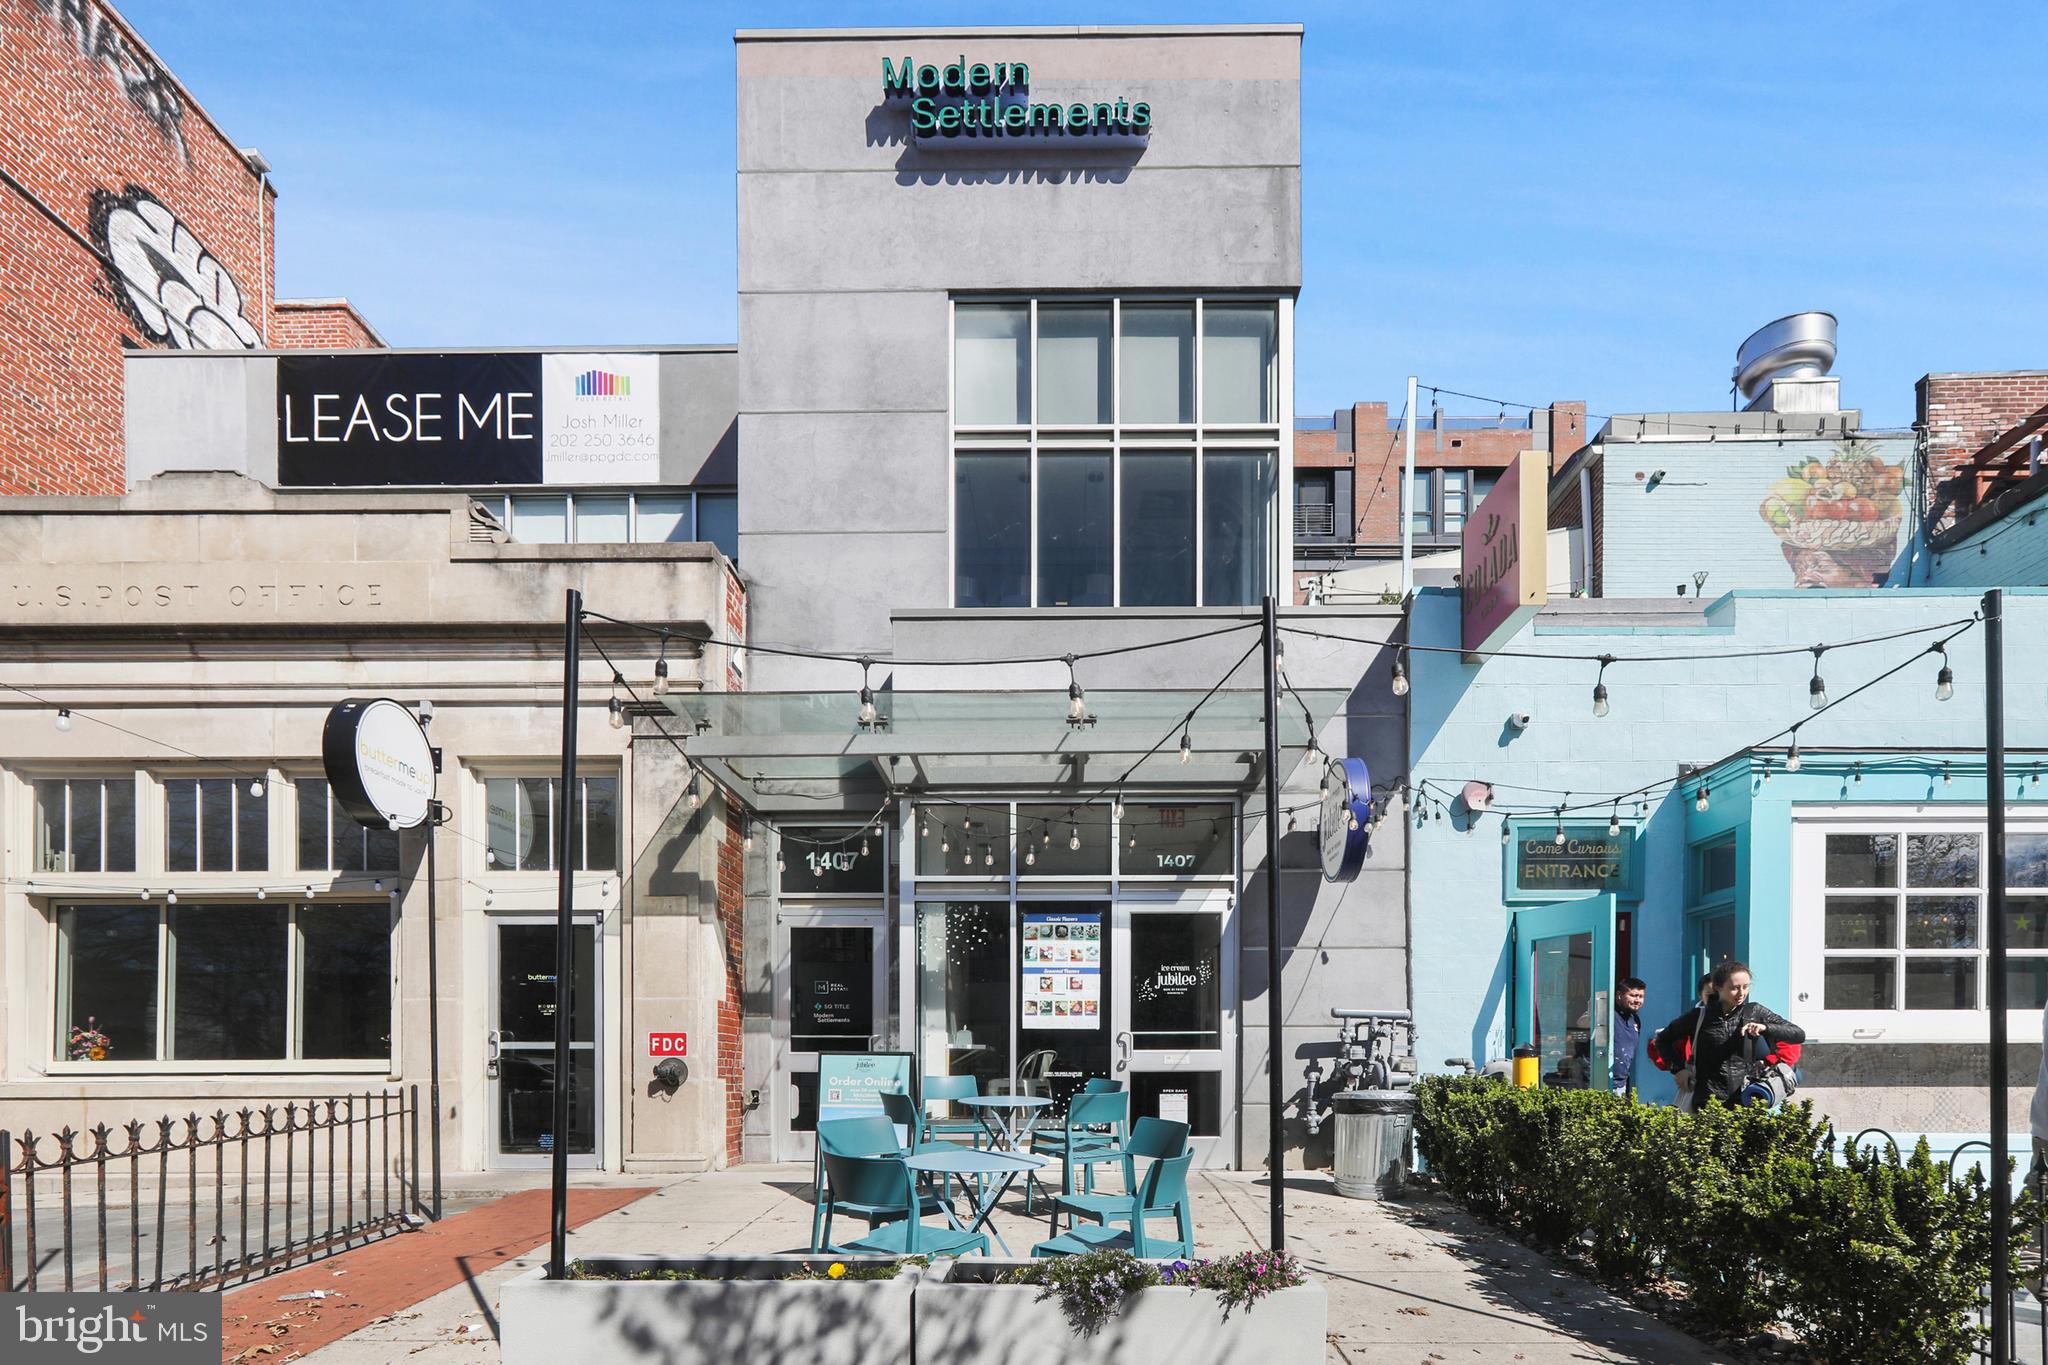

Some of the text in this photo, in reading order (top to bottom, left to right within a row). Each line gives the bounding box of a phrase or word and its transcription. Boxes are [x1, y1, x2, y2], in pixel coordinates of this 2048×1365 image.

[882, 55, 1030, 91] Modern
[912, 97, 1151, 130] Settlements
[285, 392, 534, 443] LEASE ME
[562, 413, 643, 429] Josh Miller
[550, 432, 655, 447] 202 250 3646
[228, 584, 382, 607] OFFICE
[1525, 839, 1622, 855] Come Curious
[805, 851, 859, 870] 1407
[1156, 854, 1196, 868] 1407
[1525, 863, 1620, 878] ENTRANCE
[1154, 971, 1197, 989] jubilee
[651, 1037, 685, 1052] FDC
[829, 1076, 902, 1087] Order Online
